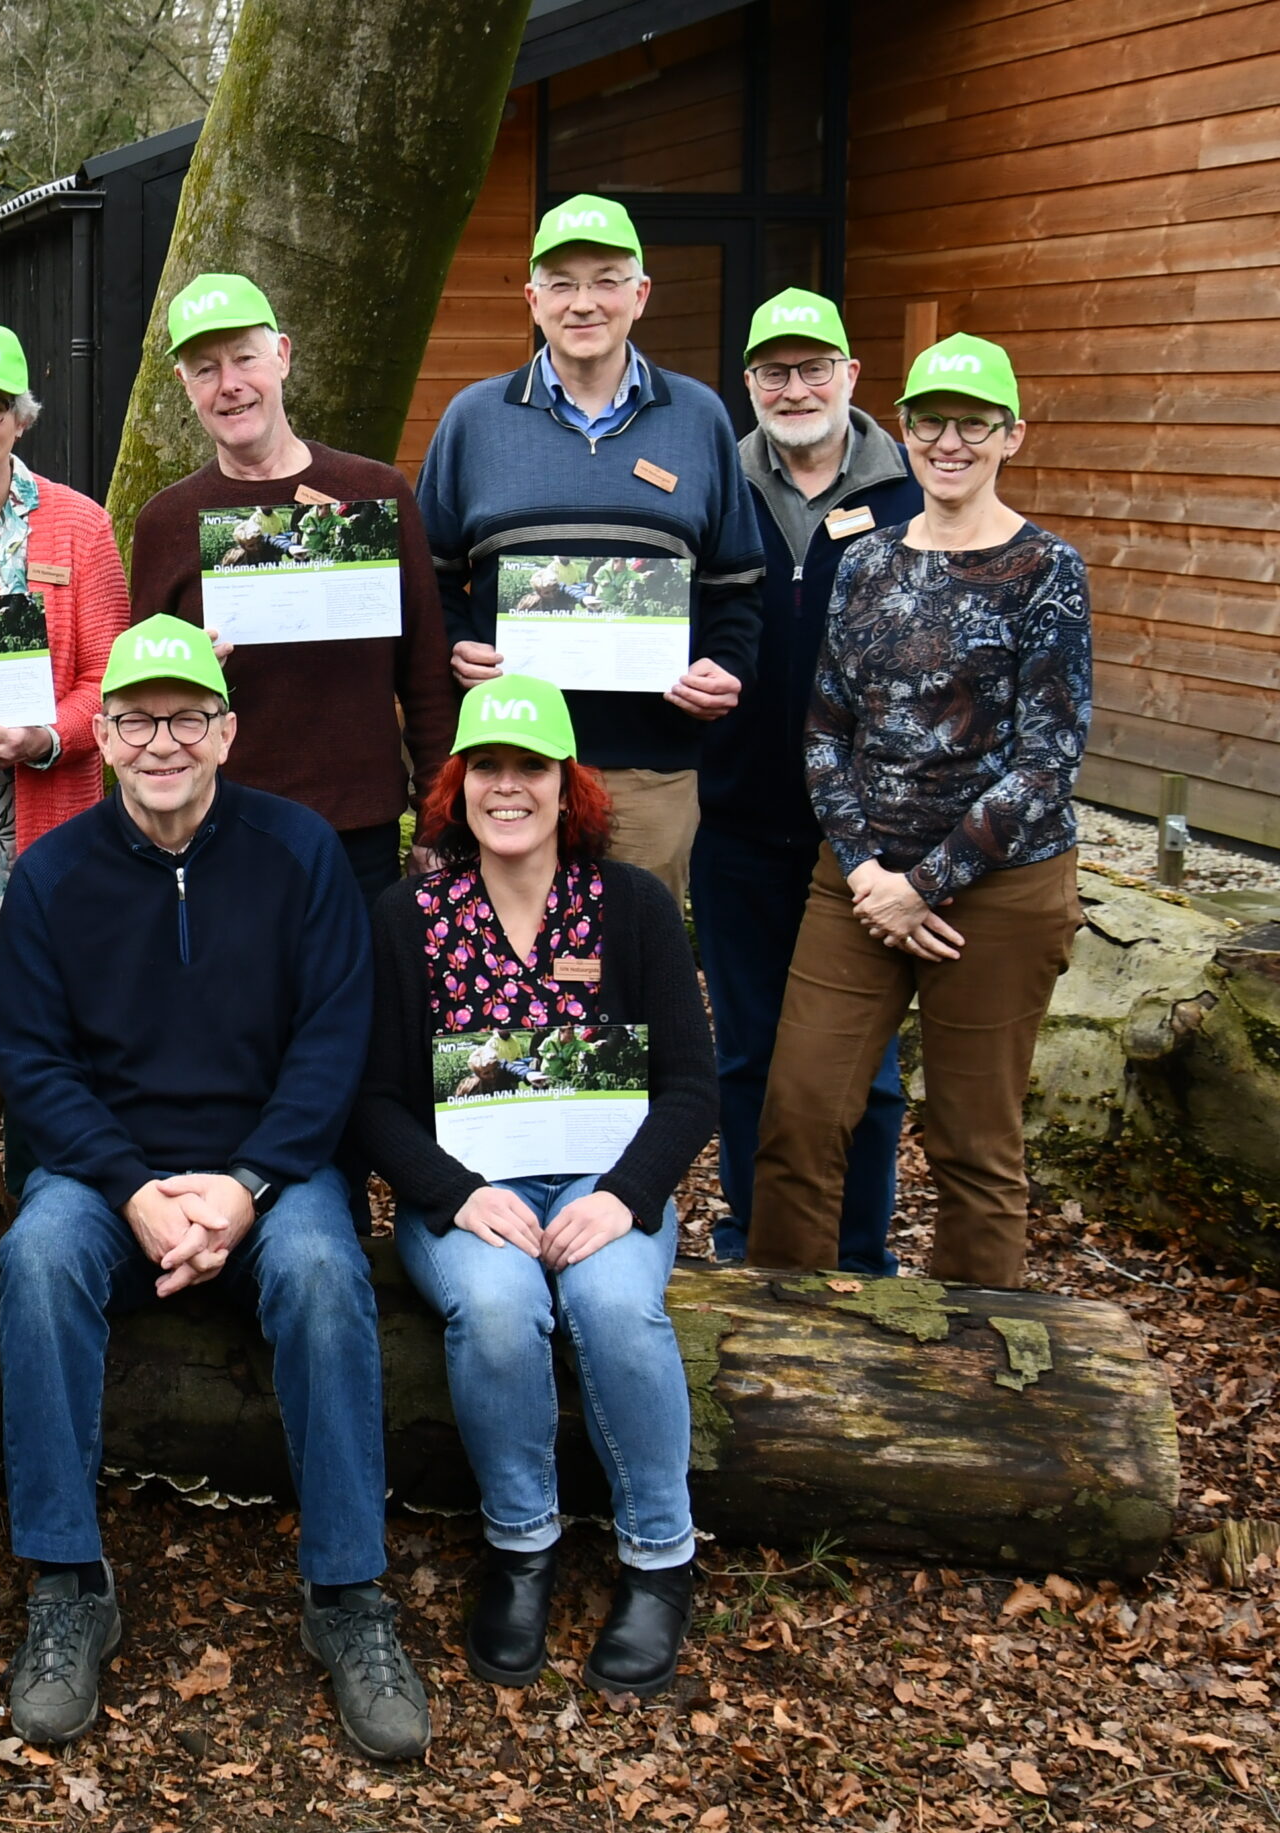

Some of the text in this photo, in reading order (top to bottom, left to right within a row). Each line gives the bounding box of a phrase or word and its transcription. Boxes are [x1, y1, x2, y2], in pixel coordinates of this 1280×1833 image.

[557, 210, 608, 234] ivn
[181, 290, 229, 321] ivn
[771, 304, 820, 326] ivn
[927, 351, 983, 376] ivn
[213, 563, 256, 576] Diploma
[133, 635, 192, 662] ivn
[480, 693, 538, 723] ivn
[447, 1086, 576, 1107] Diploma IVN Natuurgids
